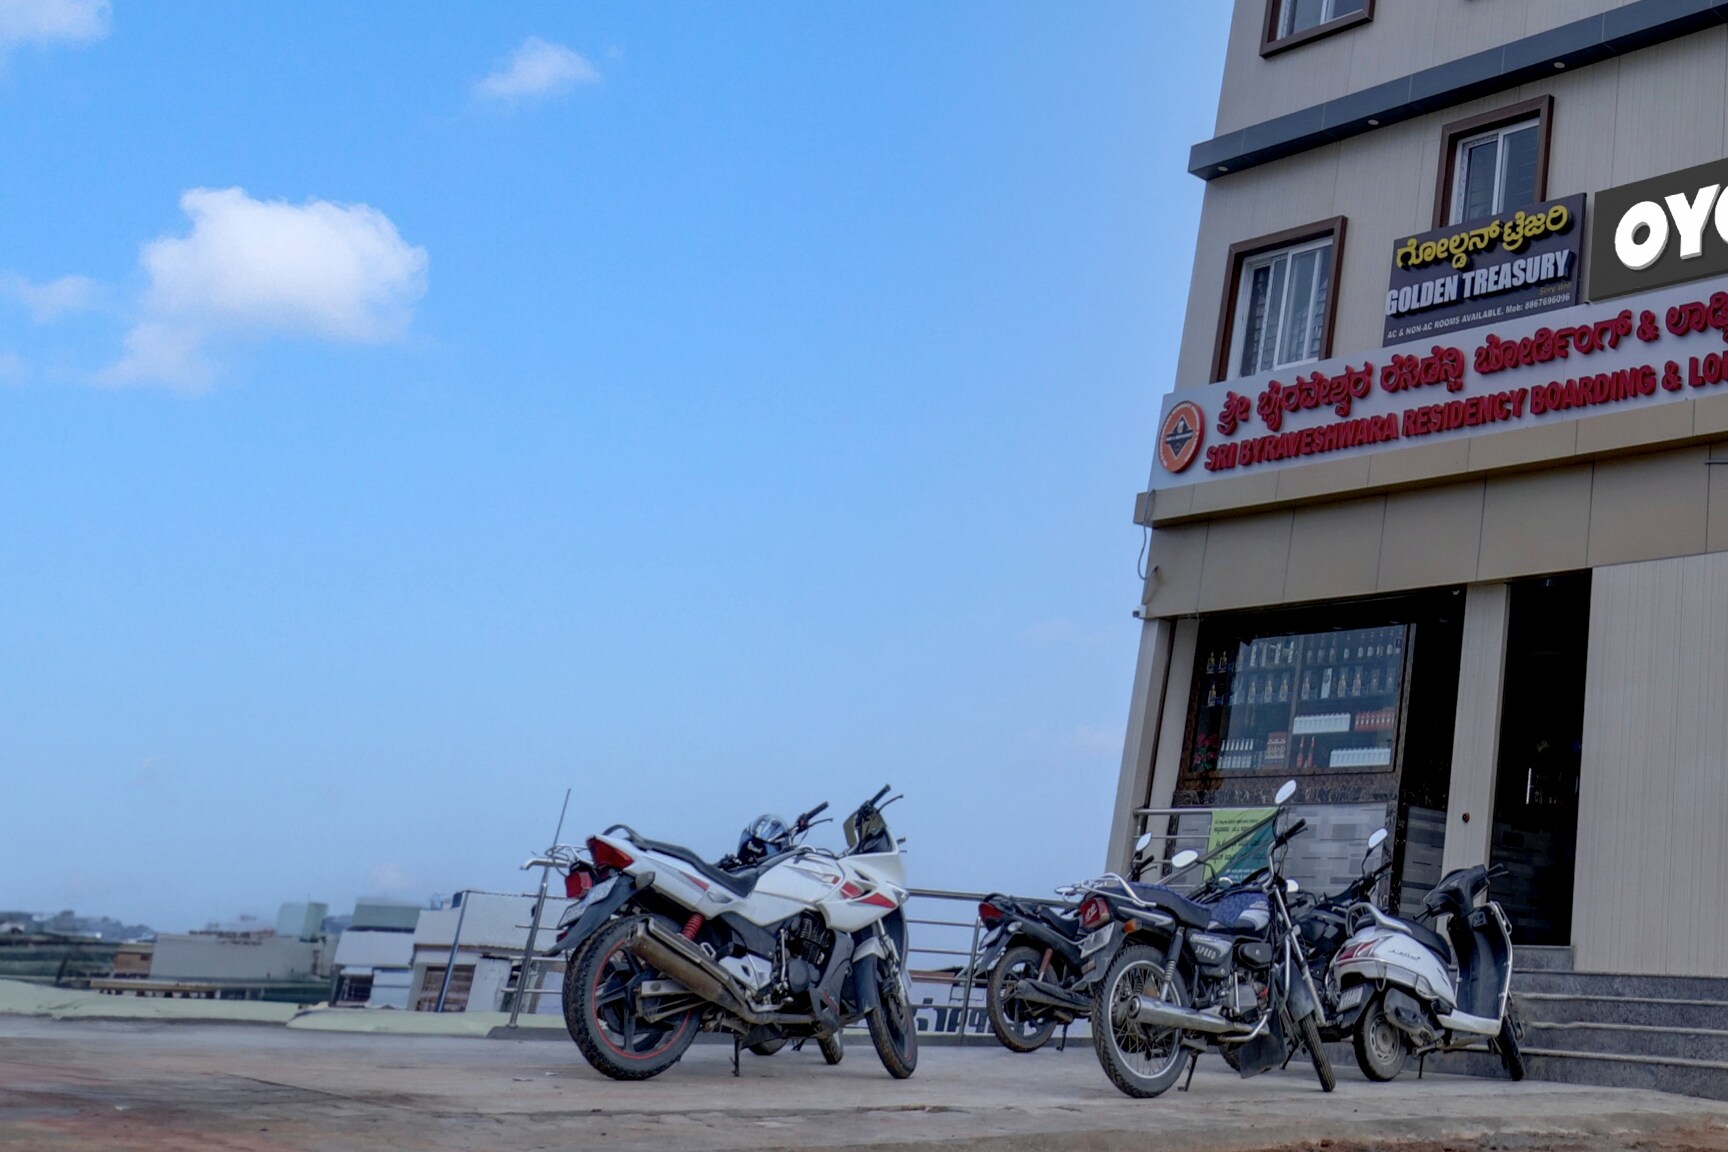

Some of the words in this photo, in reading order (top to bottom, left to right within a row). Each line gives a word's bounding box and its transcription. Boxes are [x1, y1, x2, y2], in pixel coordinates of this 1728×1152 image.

[1385, 274, 1459, 316] GOLDEN
[1462, 249, 1570, 298] TREASURY
[1636, 309, 1660, 343] &
[1204, 442, 1237, 472] SRI
[1238, 413, 1399, 467] BYRAVESHWARA
[1401, 387, 1527, 438] RESIDENCY
[1529, 364, 1657, 416] BOARDING
[1661, 360, 1682, 392] &
